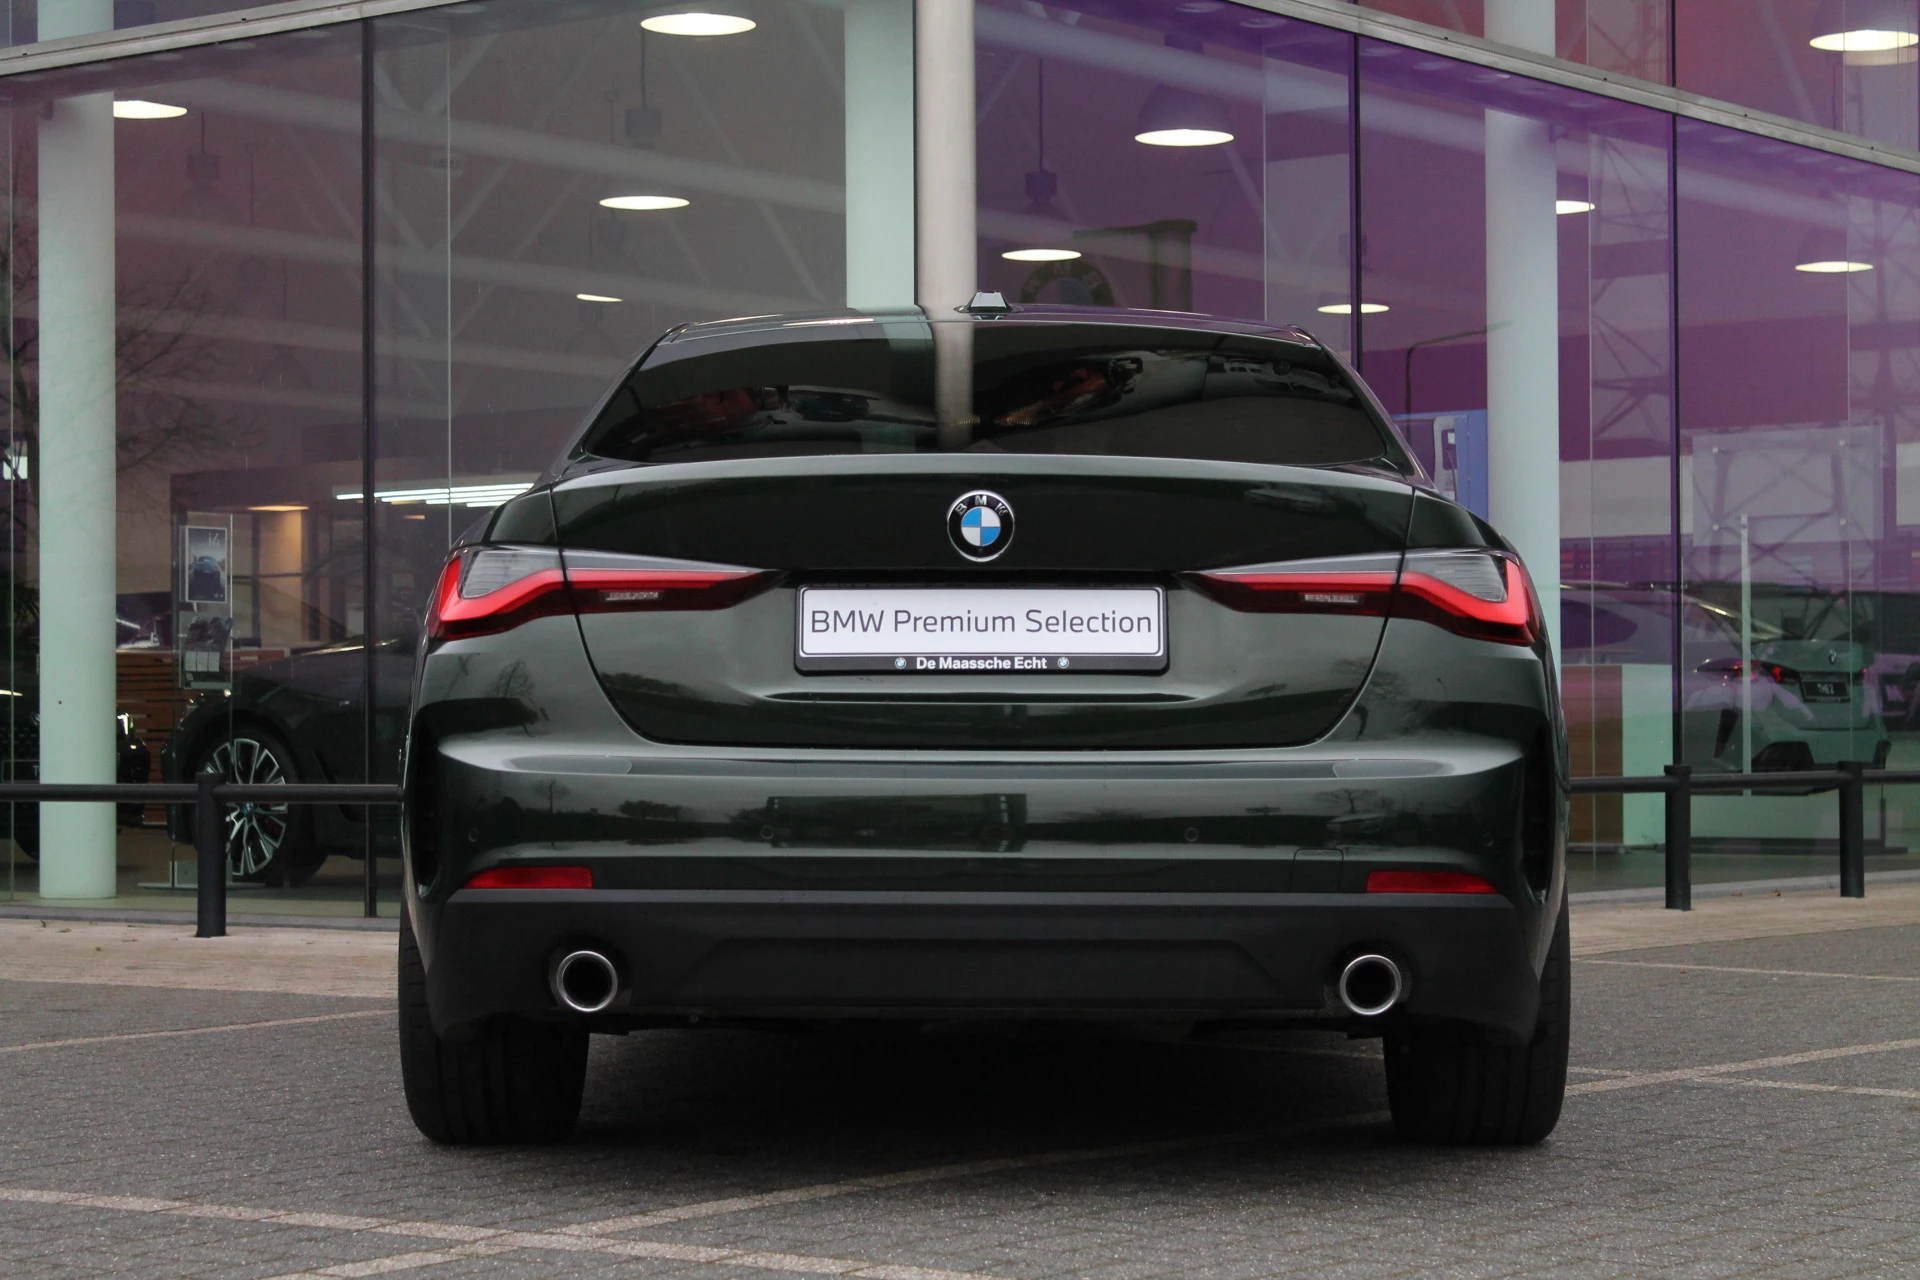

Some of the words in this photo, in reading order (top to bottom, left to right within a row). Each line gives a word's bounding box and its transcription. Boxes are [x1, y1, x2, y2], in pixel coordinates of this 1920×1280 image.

[954, 494, 1009, 517] BMW
[811, 609, 885, 633] BMW
[894, 609, 1016, 633] Premium
[1025, 609, 1152, 633] Selection
[916, 657, 937, 670] De
[938, 657, 1012, 670] Maassche
[1013, 657, 1047, 670] Echt
